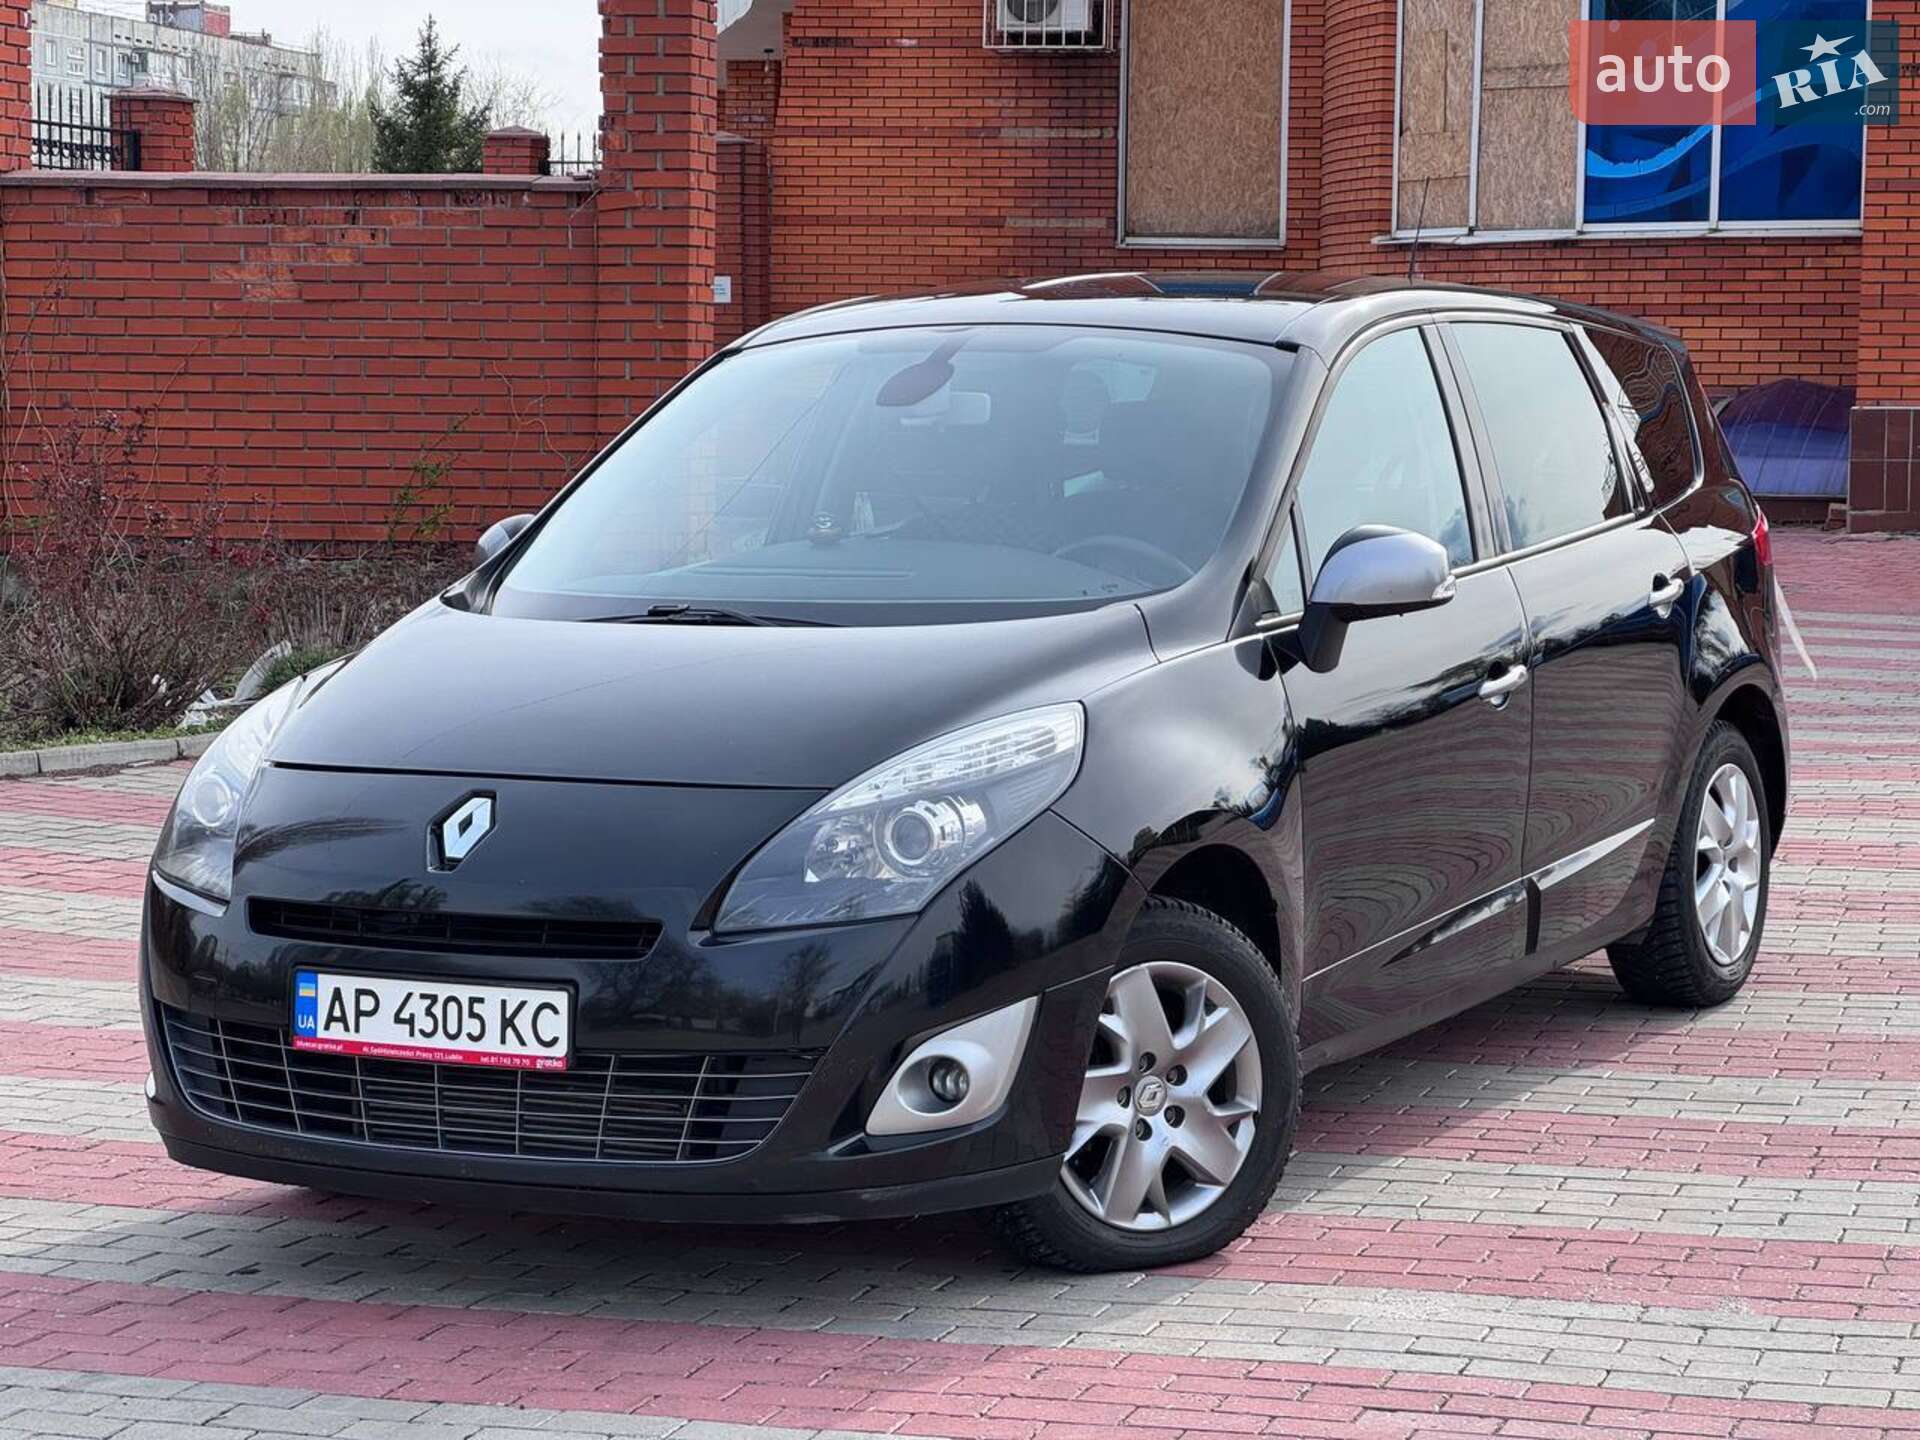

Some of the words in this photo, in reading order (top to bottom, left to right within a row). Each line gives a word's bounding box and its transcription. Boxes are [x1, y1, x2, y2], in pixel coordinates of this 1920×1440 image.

[298, 1014, 316, 1030] UA
[323, 986, 381, 1033] AP
[393, 991, 487, 1043] 4305
[499, 998, 561, 1049] KC
